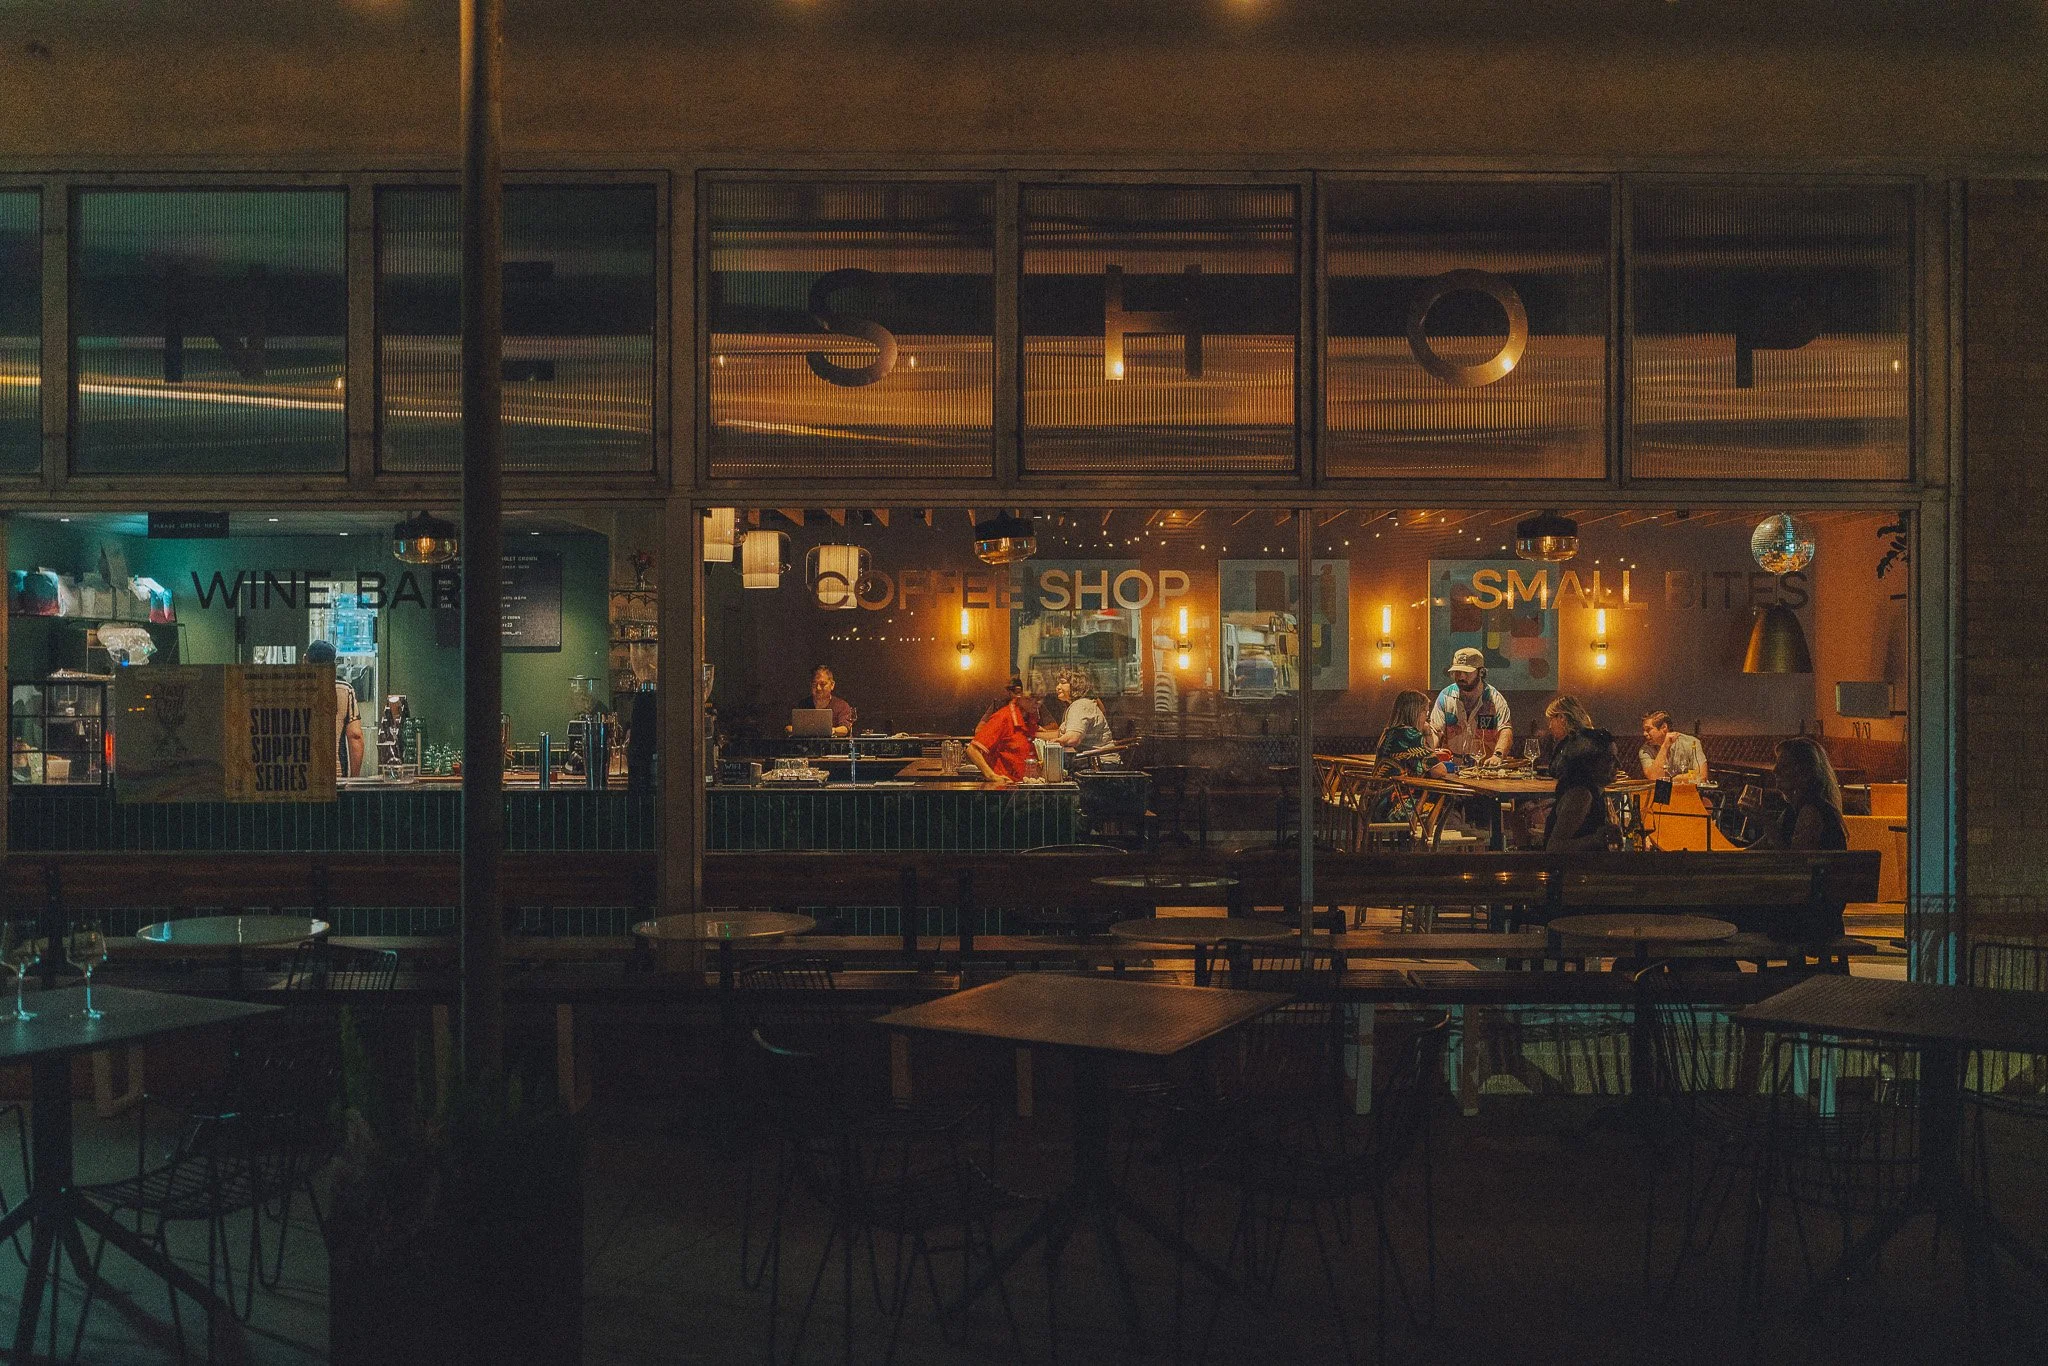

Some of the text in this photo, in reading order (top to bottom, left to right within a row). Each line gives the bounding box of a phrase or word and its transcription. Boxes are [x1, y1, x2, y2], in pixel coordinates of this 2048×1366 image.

[191, 570, 463, 610] WINE BAR
[815, 569, 1190, 610] COFFEE SHOP
[1471, 568, 1810, 611] SMALL BITES
[250, 708, 312, 735] SUNDAY
[252, 736, 311, 763] SUPPER
[255, 764, 308, 791] SERIES
